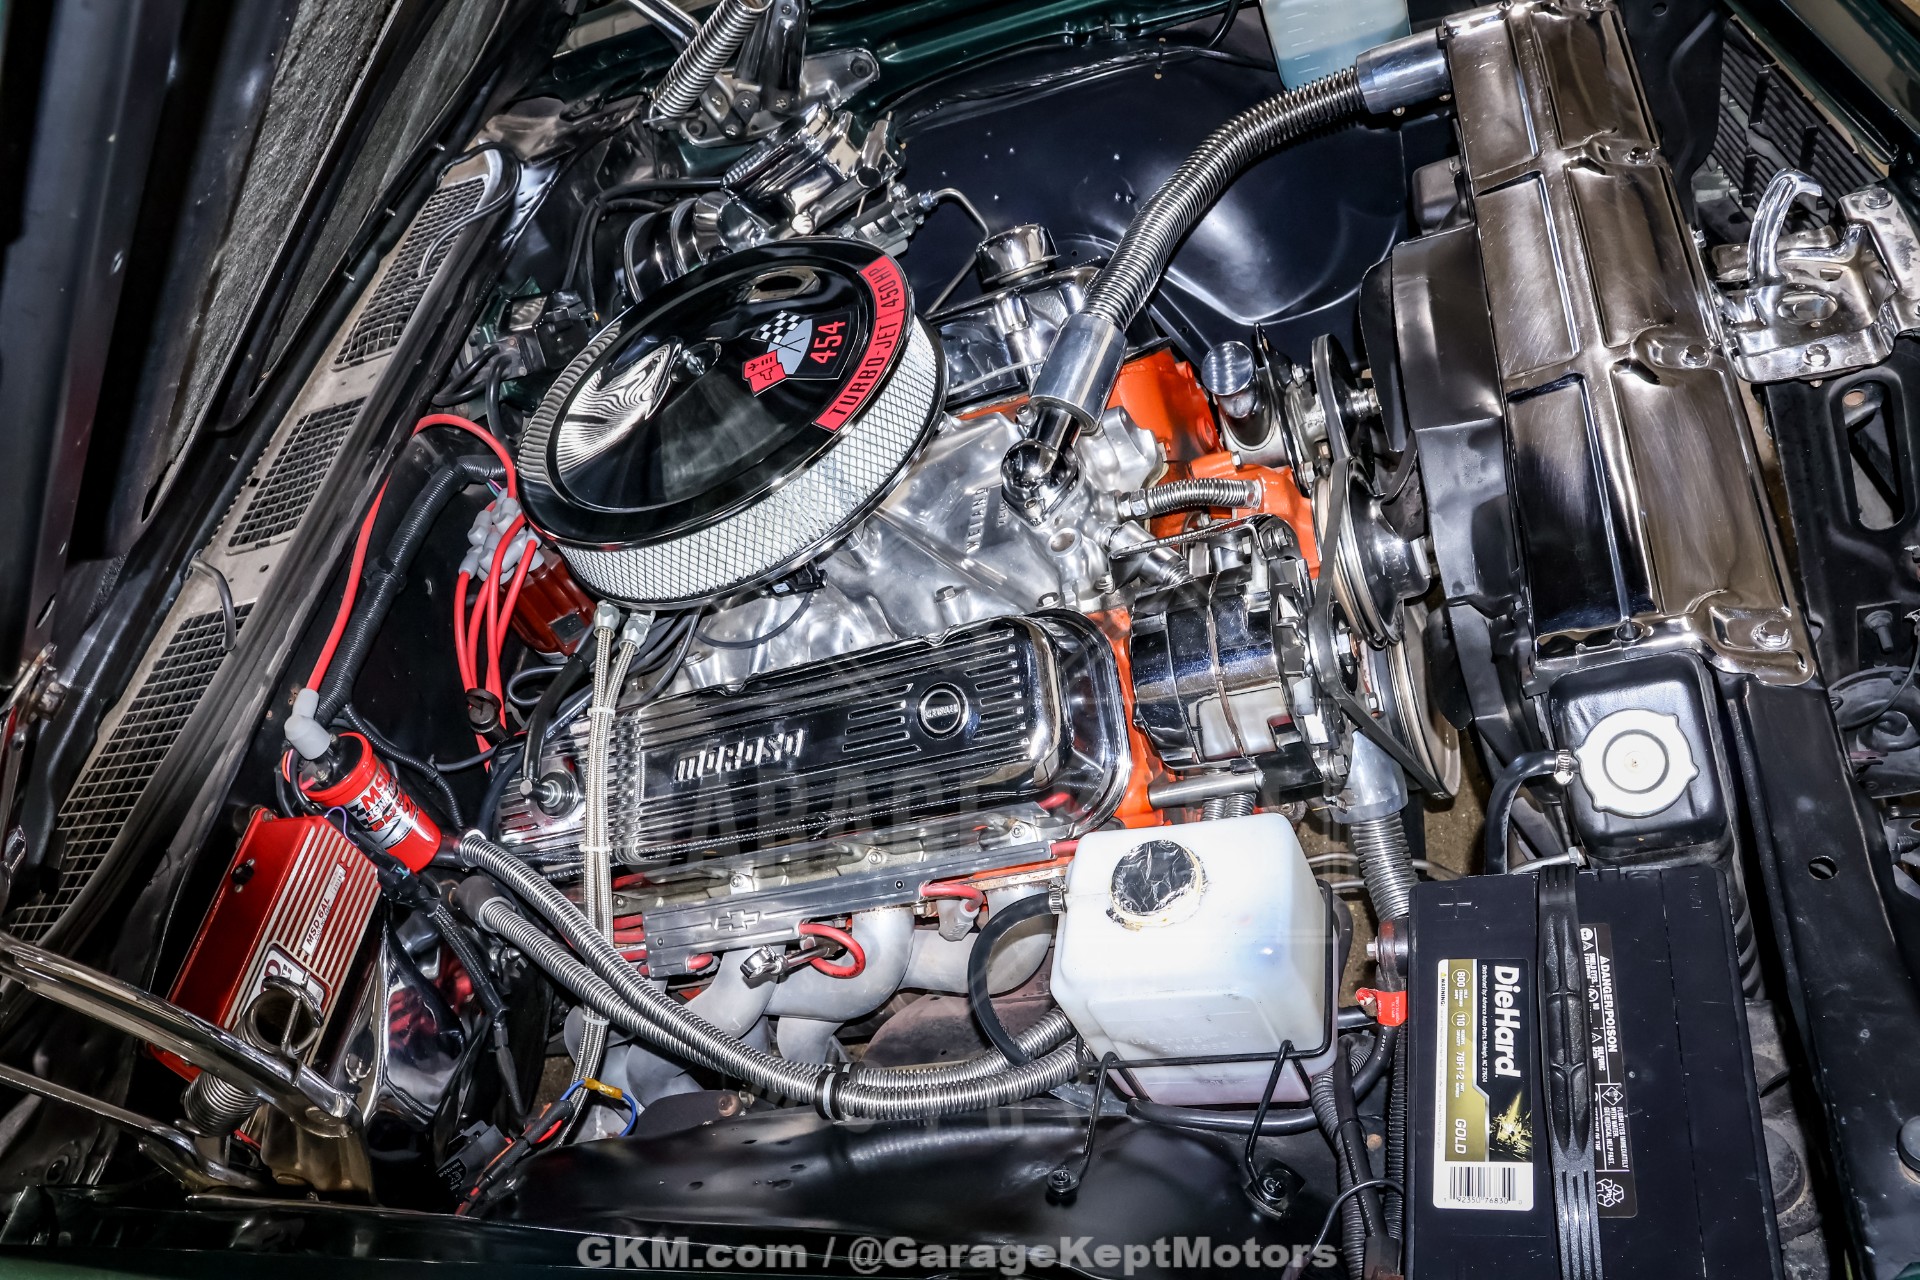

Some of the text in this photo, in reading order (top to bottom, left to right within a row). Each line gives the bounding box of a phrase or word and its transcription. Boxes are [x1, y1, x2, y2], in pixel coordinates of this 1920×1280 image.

[810, 321, 846, 364] 454
[828, 320, 898, 416] TURBO-JET
[966, 488, 989, 554] WEIAND
[360, 762, 391, 811] MSD
[306, 898, 330, 945] MSD 6AL
[1457, 972, 1466, 987] 800
[1456, 1014, 1465, 1026] 110
[1600, 964, 1618, 1053] DANGER/POISON
[1456, 1051, 1465, 1080] 78FT-2
[1455, 1118, 1466, 1154] GOLD
